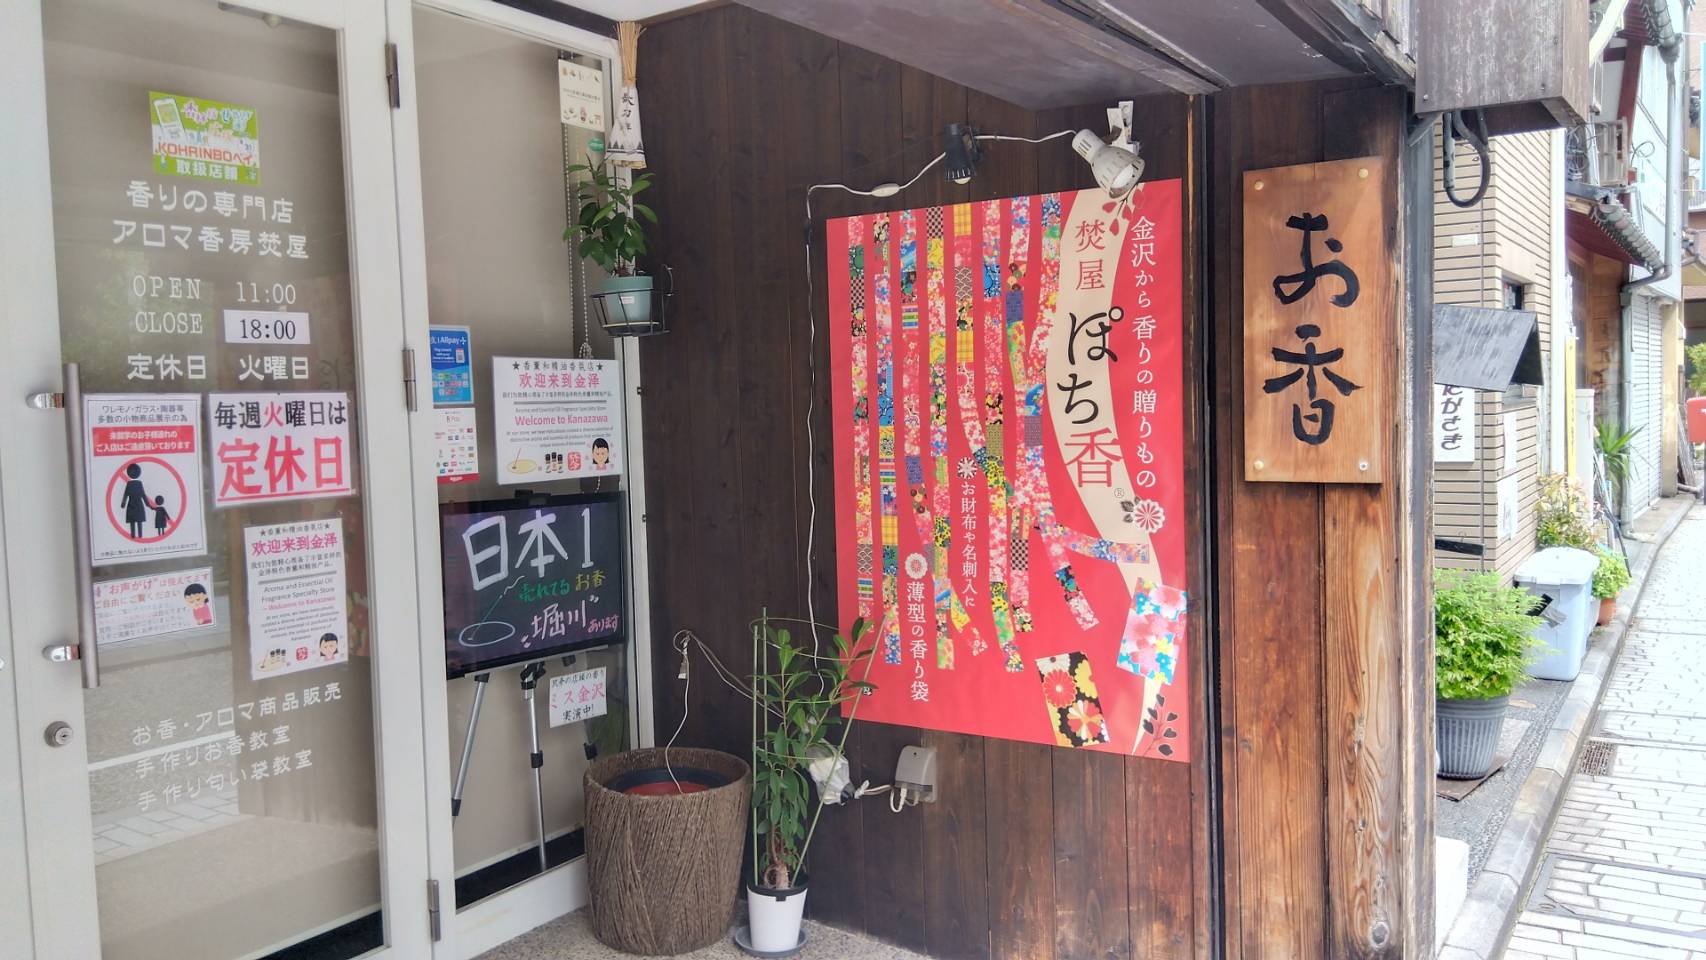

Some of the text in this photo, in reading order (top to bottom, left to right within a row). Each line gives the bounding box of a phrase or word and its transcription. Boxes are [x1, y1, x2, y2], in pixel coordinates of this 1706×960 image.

[126, 180, 295, 224] 香りの専門店
[112, 219, 310, 259] アロマ香房焚屋
[133, 275, 296, 305] OPEN 11:00
[135, 311, 296, 341] CLOSE 18:00
[1263, 212, 1364, 446] お香
[127, 353, 309, 382] 定休日 火曜日
[1057, 219, 1124, 488] 焚屋 ぽち香
[1131, 215, 1158, 489] 金沢から香りの贈りもの
[519, 372, 601, 389] 欢迎来到金泽
[214, 400, 347, 430] 毎週火曜日は
[515, 414, 609, 426] Welcome to Kanazawa
[217, 435, 343, 497] 定休日
[251, 532, 338, 557] 欢迎来到金泽
[462, 507, 595, 591] 日本1
[961, 481, 978, 607] お財布や名刺入に
[576, 569, 606, 591] お香
[906, 581, 929, 702] 薄型の香り袋
[132, 682, 342, 746] お香・アロマ商品販売
[135, 725, 291, 780] 手作りお香教室
[138, 749, 313, 812] 手作り匂い袋教室
